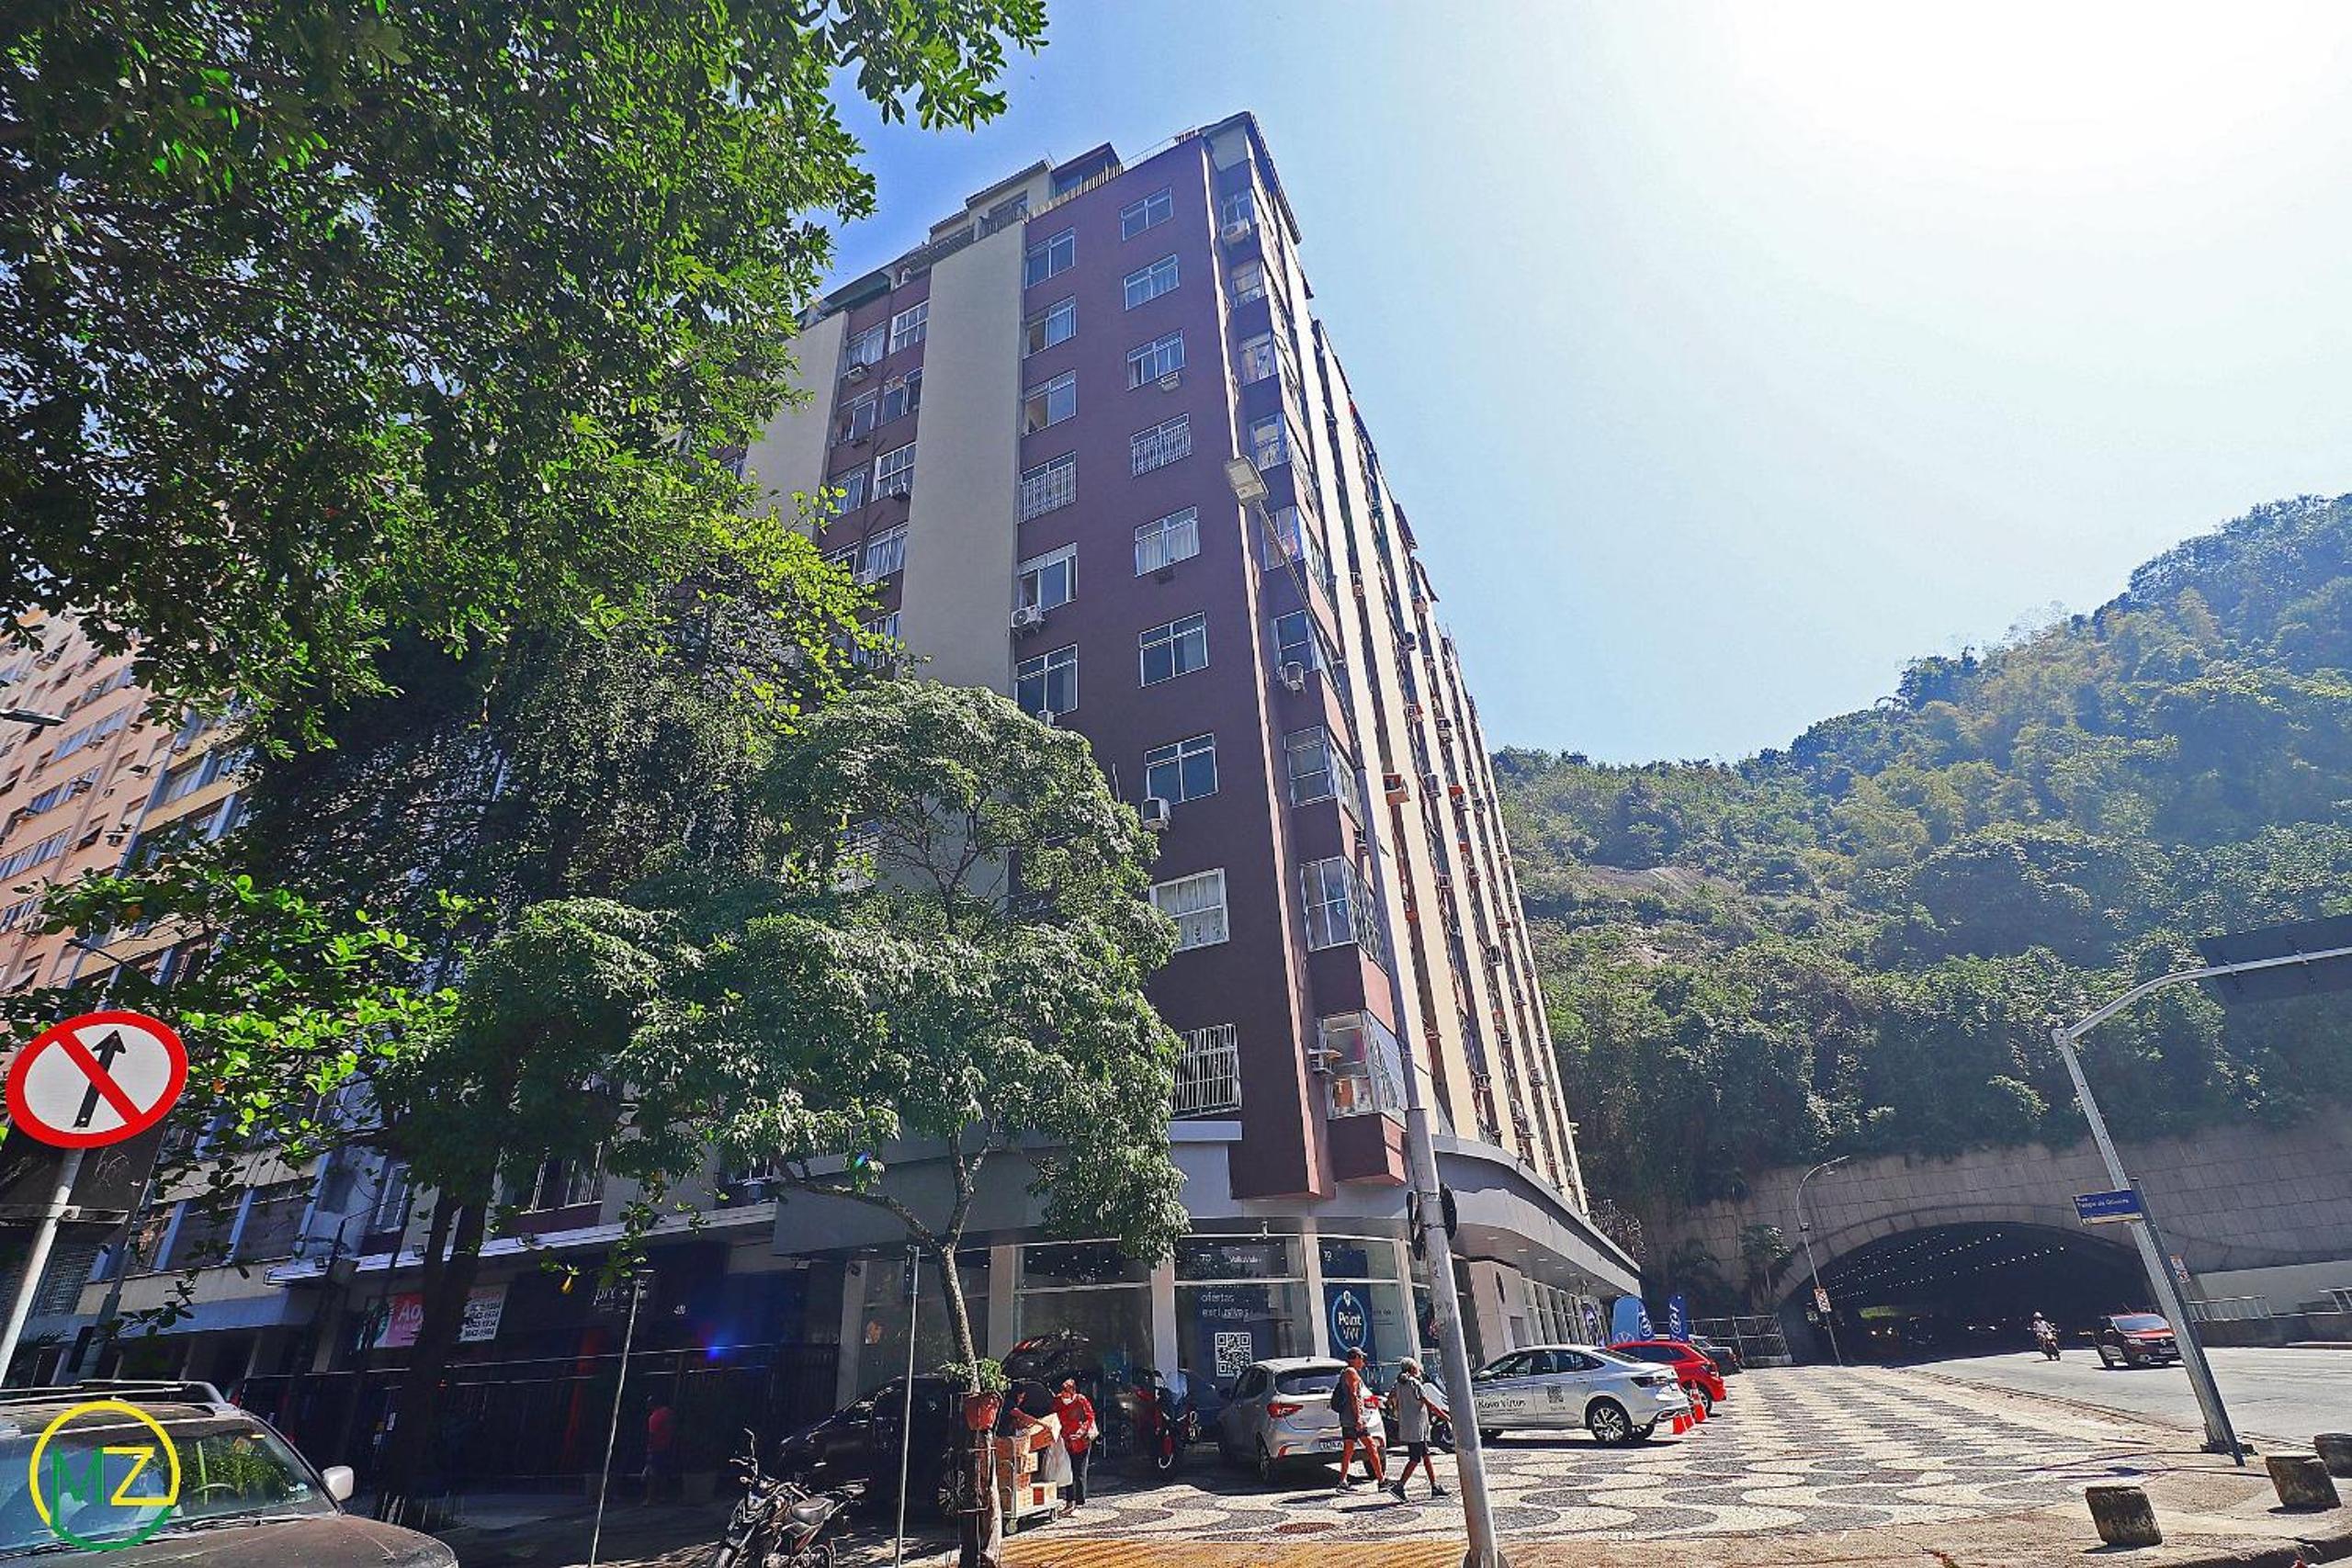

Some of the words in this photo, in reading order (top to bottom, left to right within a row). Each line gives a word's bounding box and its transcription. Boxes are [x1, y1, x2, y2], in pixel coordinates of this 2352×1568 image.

[1338, 1311, 1362, 1325] Point
[1477, 1398, 1500, 1409] Novo
[1500, 1397, 1526, 1408] Virtus
